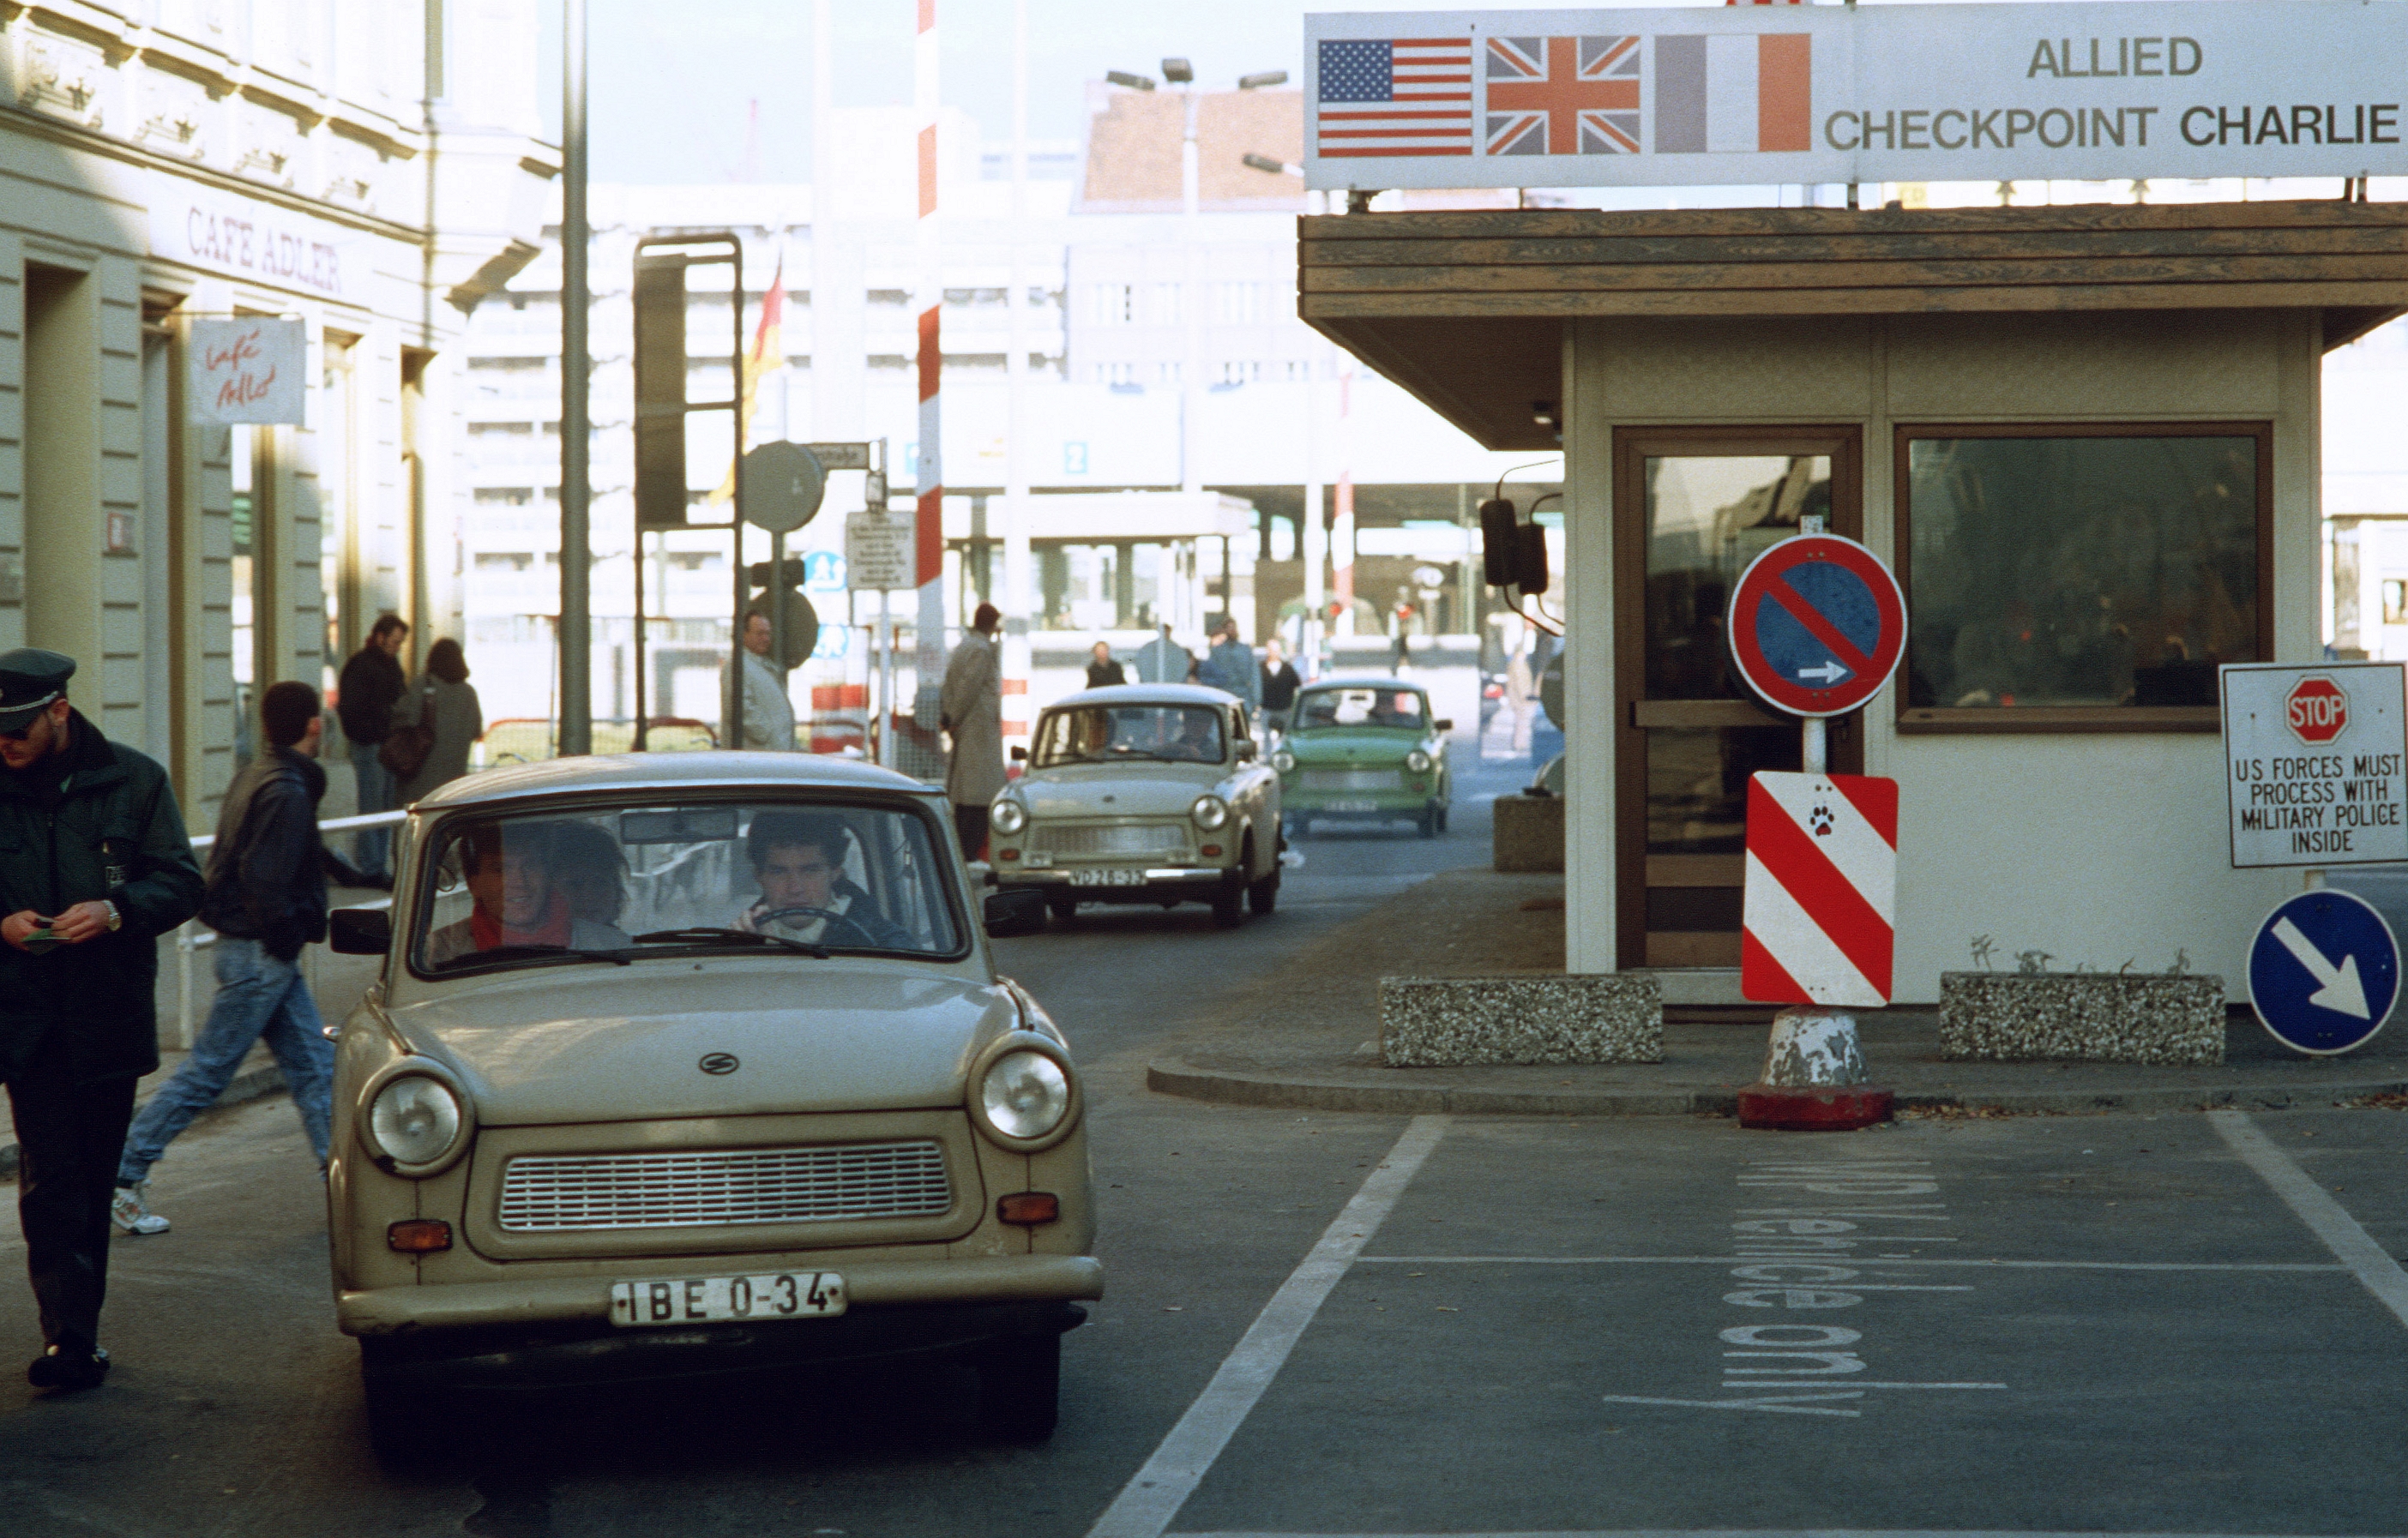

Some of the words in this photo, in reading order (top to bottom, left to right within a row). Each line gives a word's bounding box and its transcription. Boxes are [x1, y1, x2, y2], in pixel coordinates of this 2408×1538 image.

[2026, 36, 2204, 78] ALLIED
[1824, 106, 2158, 150] CHECKPOINT
[2179, 104, 2400, 146] CHARLIE
[262, 227, 342, 293] ADLER
[1068, 443, 1084, 470] 2
[2290, 694, 2345, 728] STOP
[2236, 759, 2264, 782] US
[2273, 756, 2343, 780] FORCES
[2354, 754, 2400, 777] MUST
[2250, 782, 2334, 806] PROCESS
[2344, 778, 2388, 802] WITH
[2241, 806, 2325, 831] MILITARY
[2335, 803, 2400, 828] POLICE
[2291, 830, 2354, 854] INSIDE
[1602, 1323, 2009, 1418] only
